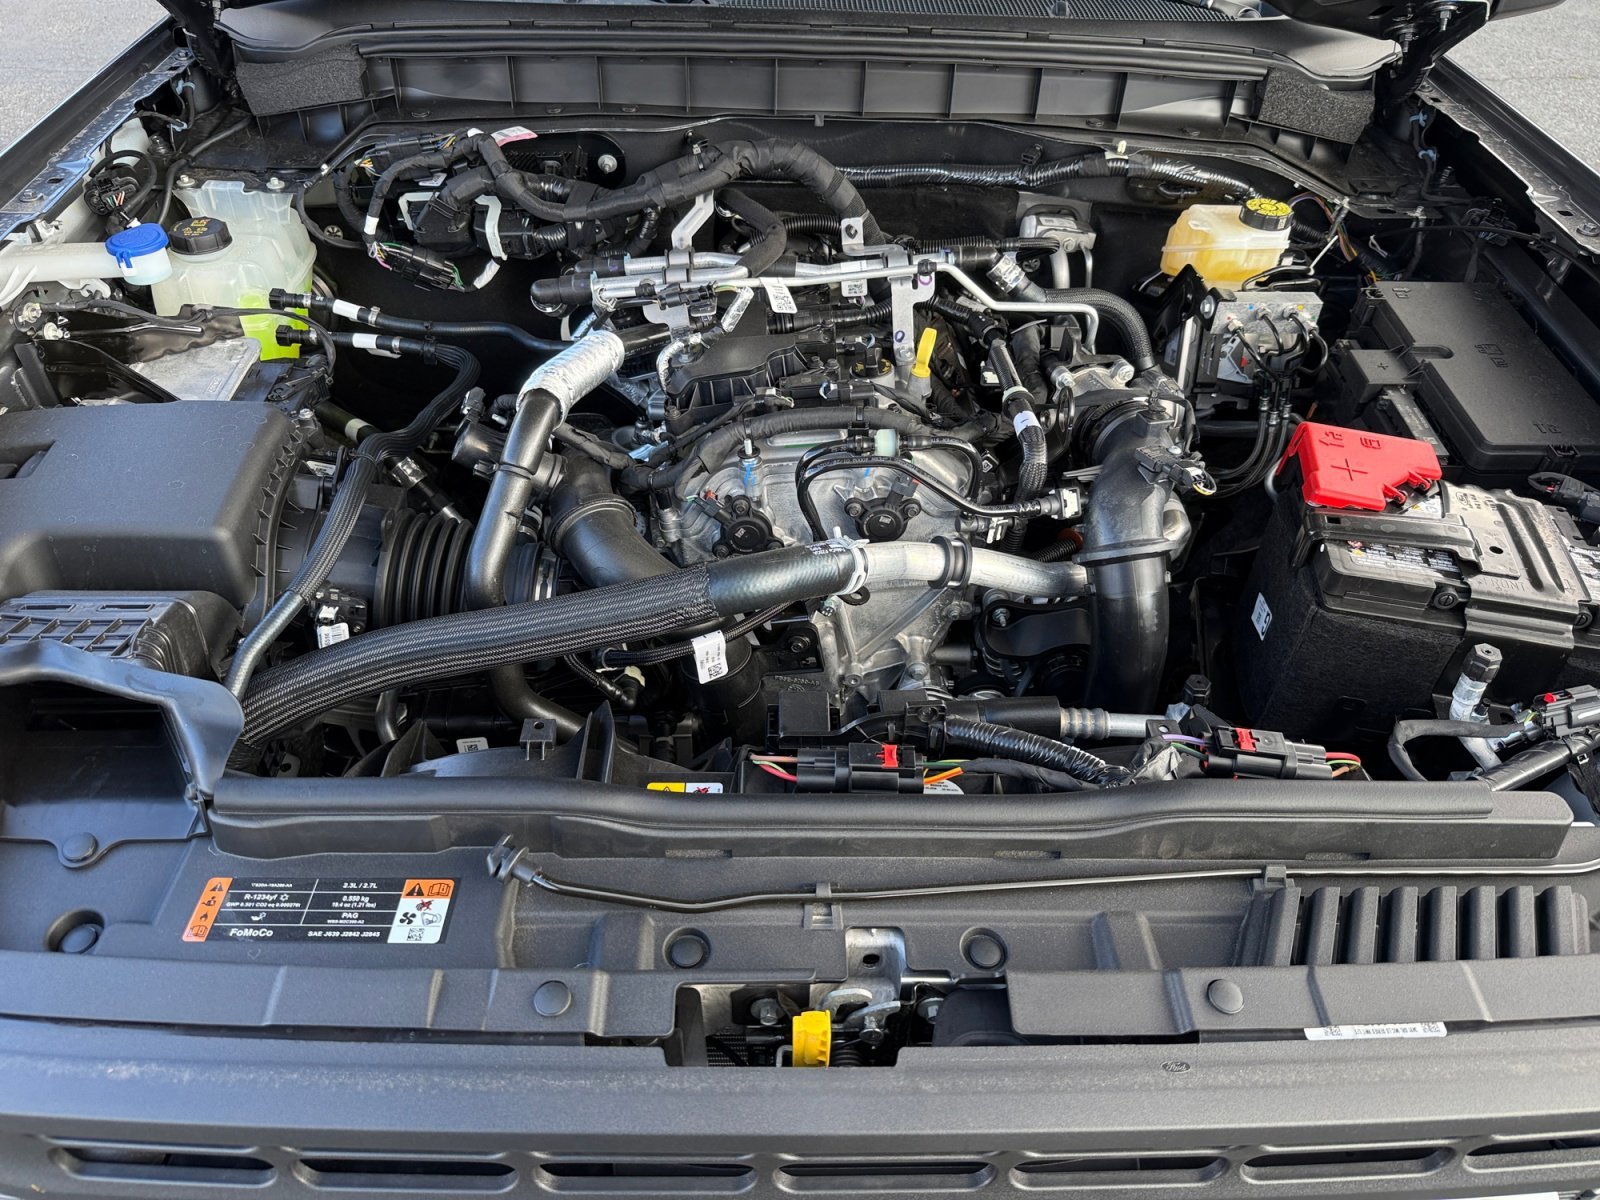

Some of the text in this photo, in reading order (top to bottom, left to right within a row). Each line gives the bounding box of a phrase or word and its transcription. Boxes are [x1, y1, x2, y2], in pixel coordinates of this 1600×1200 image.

[244, 893, 278, 904] R-1234yf
[360, 895, 369, 904] kg
[229, 928, 273, 937] FoMoCo
